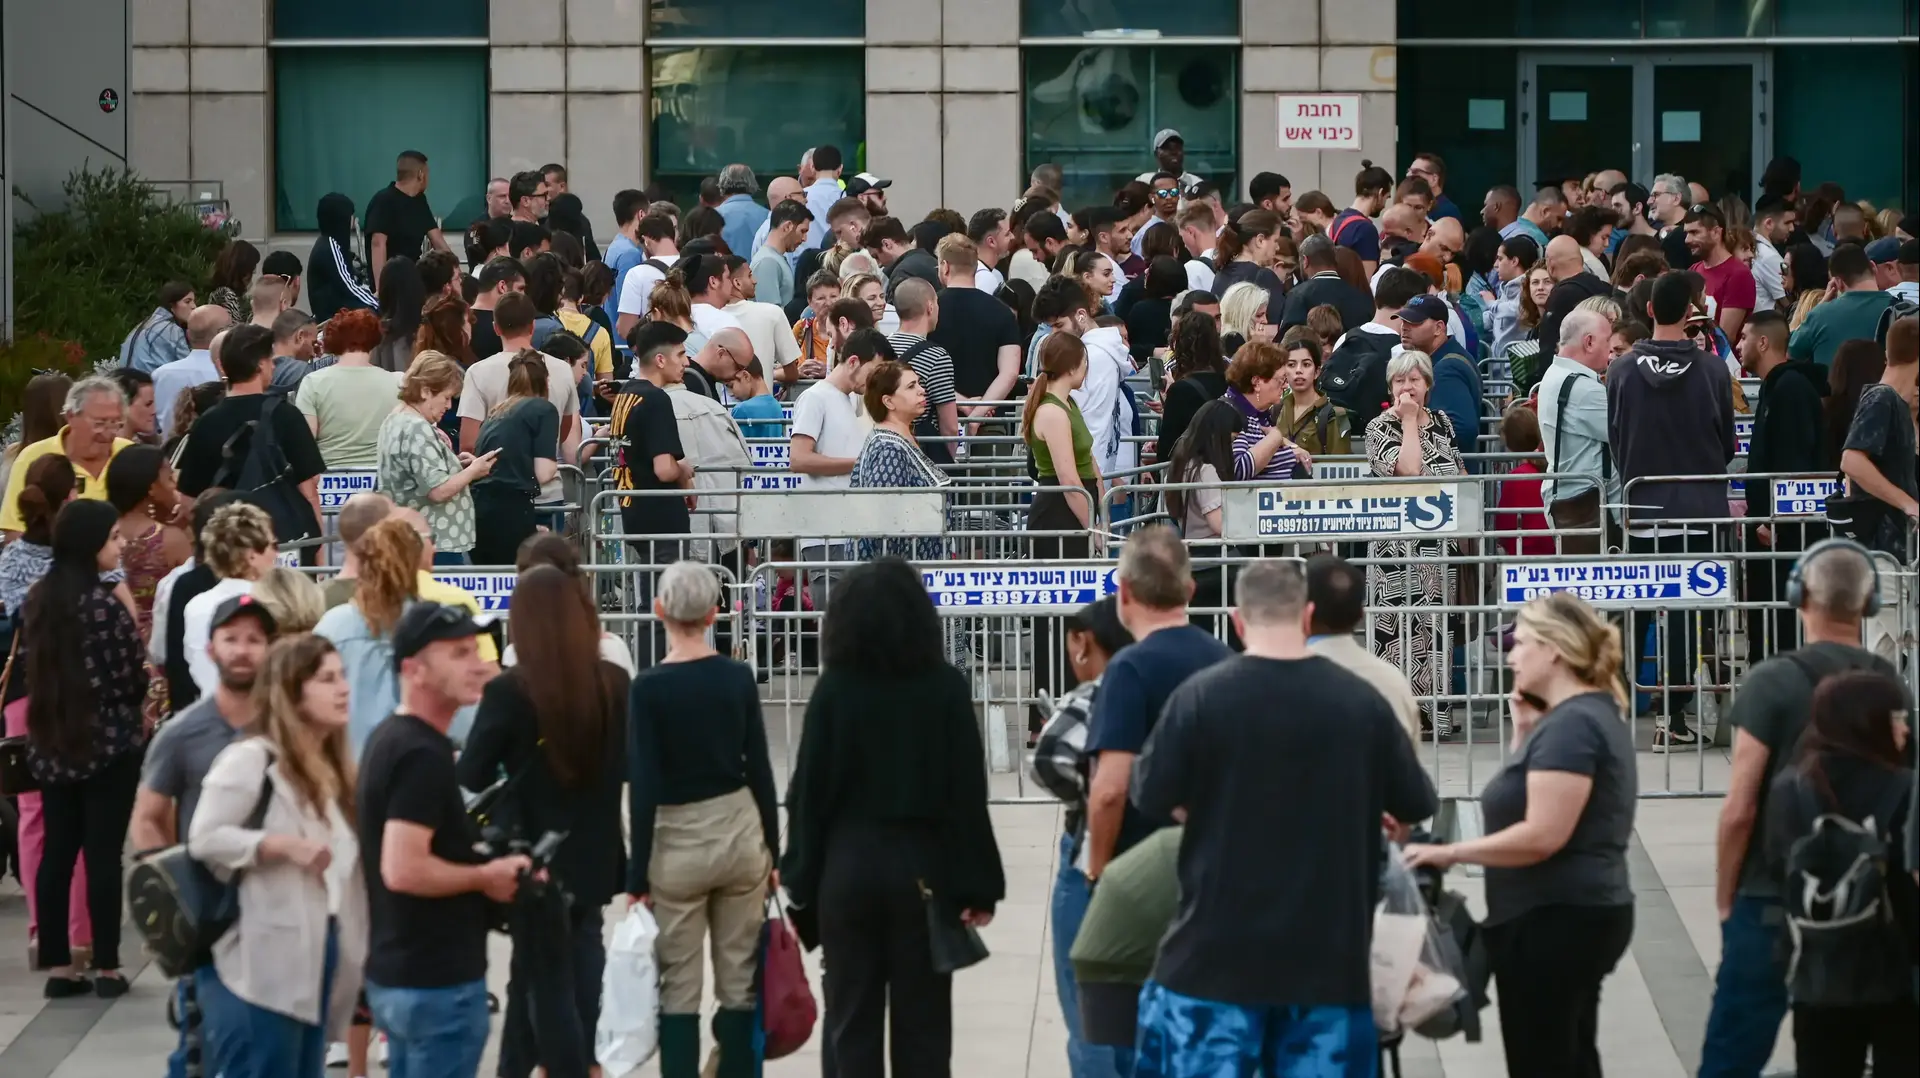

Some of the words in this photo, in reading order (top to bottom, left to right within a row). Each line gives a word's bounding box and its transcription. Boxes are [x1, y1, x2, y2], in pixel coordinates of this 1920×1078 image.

[1297, 104, 1341, 117] רחבת
[1285, 127, 1312, 140] אש
[1318, 127, 1353, 140] כיבוי
[756, 446, 784, 458] ציוד
[322, 476, 372, 489] השכרת
[1260, 518, 1320, 534] 09-8997817
[1322, 513, 1356, 531] לאירועים
[1356, 516, 1372, 530] ציוד
[1373, 516, 1399, 530] השכרת
[969, 572, 1004, 586] ציוד
[1007, 571, 1066, 586] השכרת
[1070, 570, 1097, 588] שון
[1554, 567, 1588, 581] ציוד
[1592, 565, 1650, 581] השכרת
[1655, 564, 1682, 582] שון
[1695, 560, 1720, 597] S
[492, 577, 515, 594] שון
[939, 590, 1080, 605] 09-8997817
